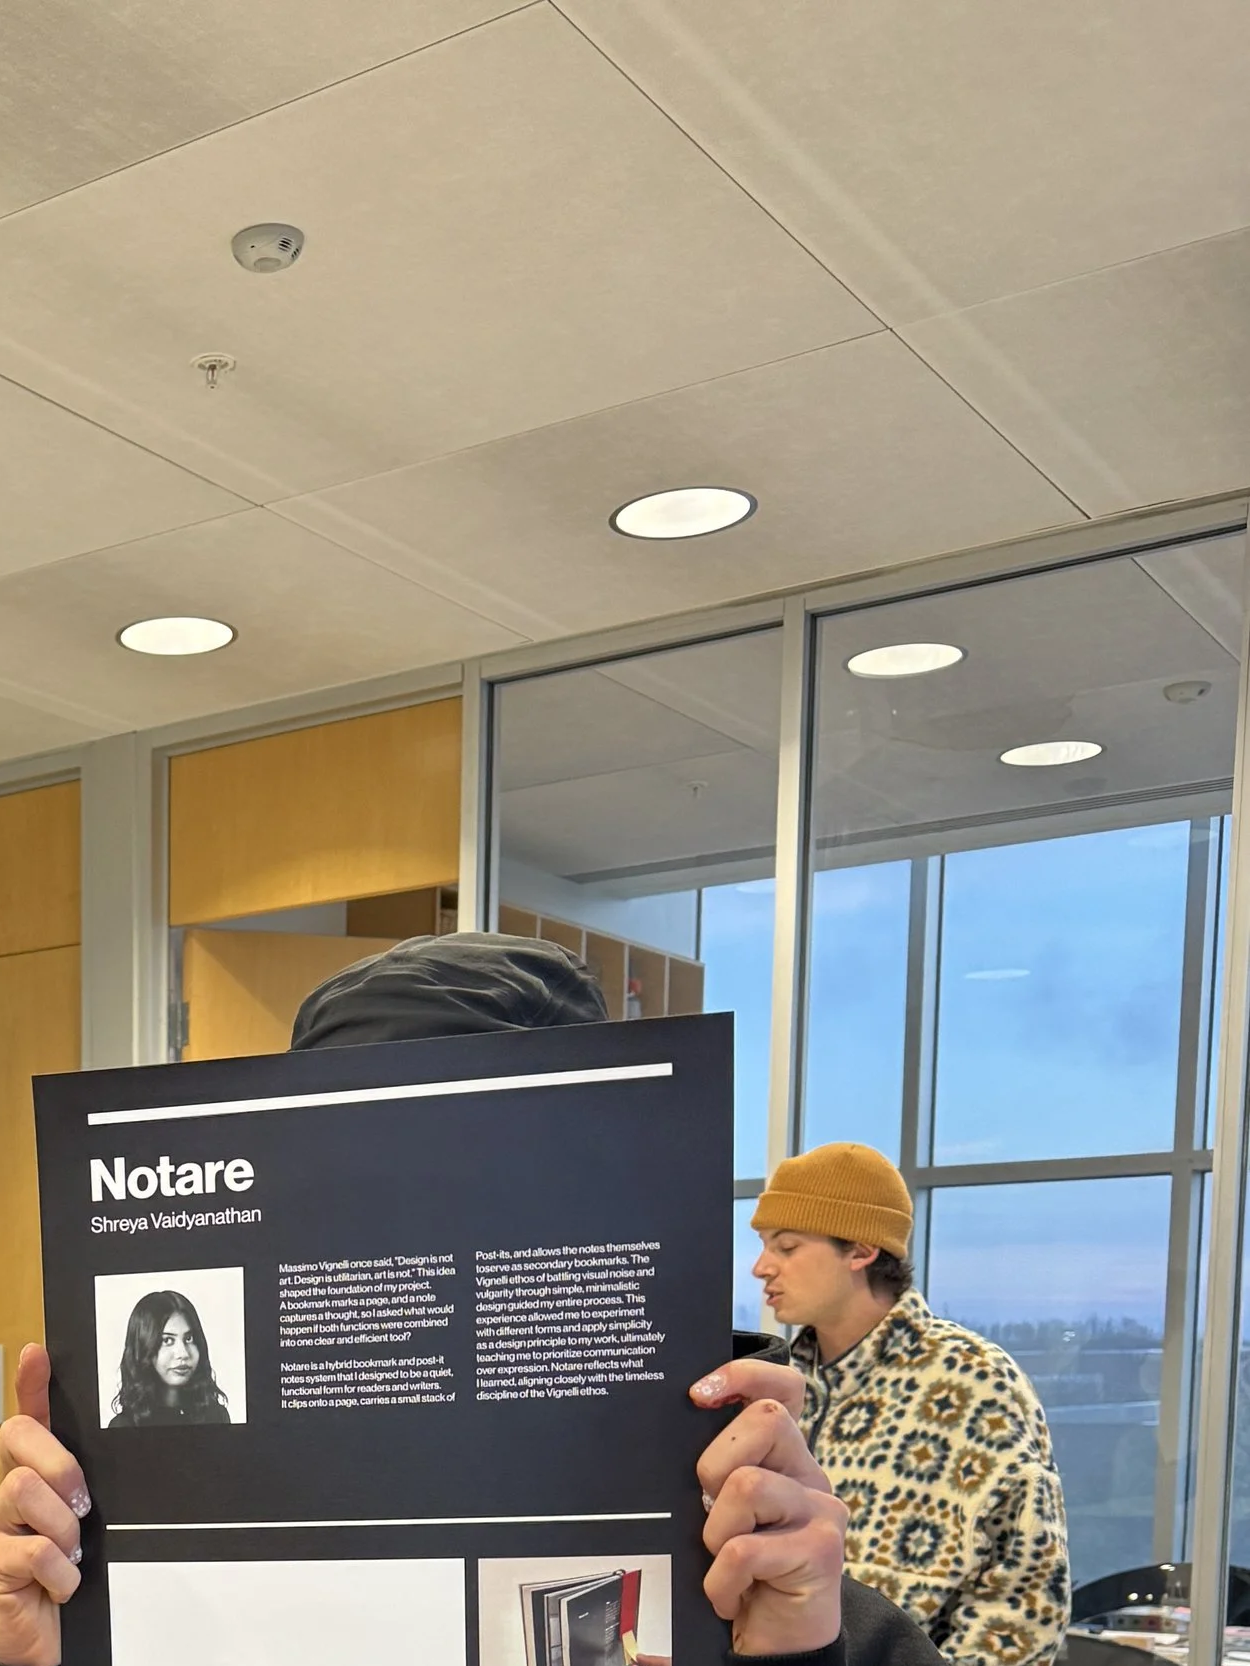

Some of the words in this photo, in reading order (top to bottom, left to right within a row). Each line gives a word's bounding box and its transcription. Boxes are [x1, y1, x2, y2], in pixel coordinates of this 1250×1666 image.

[90, 1156, 254, 1202] Notare
[91, 1216, 148, 1234] Shreya
[151, 1208, 261, 1230] Vaidyanathan
[513, 1248, 530, 1258] and
[532, 1247, 560, 1256] allows
[562, 1246, 577, 1254] the
[578, 1244, 605, 1253] notes
[606, 1241, 660, 1252] themselves
[279, 1263, 318, 1272] Massimo
[318, 1259, 348, 1271] Vignelli
[350, 1260, 372, 1268] once
[438, 1254, 452, 1262] not
[523, 1259, 572, 1270] secondary
[574, 1255, 628, 1267] bookmarks.
[630, 1254, 649, 1263] The
[279, 1276, 292, 1285] art.
[294, 1274, 324, 1285] Design
[374, 1270, 386, 1279] art
[416, 1267, 435, 1276] This
[436, 1266, 455, 1275] idea
[476, 1275, 508, 1287] Vignelli
[509, 1274, 534, 1284] ethos
[546, 1271, 580, 1282] battling
[582, 1269, 608, 1279] visual
[609, 1268, 635, 1278] noise
[636, 1266, 654, 1276] and
[279, 1287, 311, 1298] shaped
[312, 1287, 326, 1295] the
[327, 1284, 372, 1294] foundation
[398, 1280, 431, 1292] project.
[476, 1288, 514, 1300] vulgarity
[515, 1285, 550, 1297] through
[586, 1280, 639, 1292] minimalistic
[287, 1298, 330, 1309] bookmark
[331, 1297, 358, 1307] marks
[391, 1294, 408, 1303] and
[416, 1293, 436, 1302] note
[476, 1301, 506, 1312] design
[507, 1299, 538, 1311] guided
[556, 1297, 582, 1307] entire
[583, 1296, 623, 1307] process.
[625, 1293, 645, 1303] This
[280, 1313, 317, 1323] captures
[376, 1307, 402, 1317] asked
[404, 1306, 425, 1315] what
[426, 1304, 454, 1314] would
[476, 1313, 526, 1325] experience
[528, 1311, 563, 1321] allowed
[592, 1307, 644, 1319] experiment
[280, 1326, 312, 1335] happen
[319, 1323, 338, 1332] both
[340, 1321, 379, 1331] functions
[380, 1321, 402, 1329] were
[404, 1317, 448, 1328] combined
[476, 1327, 494, 1337] with
[496, 1325, 532, 1336] different
[534, 1324, 561, 1333] forms
[562, 1322, 580, 1332] and
[582, 1321, 607, 1332] apply
[608, 1319, 652, 1330] simplicity
[280, 1338, 296, 1346] into
[314, 1336, 335, 1345] clear
[336, 1335, 353, 1344] and
[354, 1333, 388, 1343] efficient
[495, 1339, 526, 1349] design
[527, 1336, 566, 1348] principle
[620, 1332, 664, 1342] ultimately
[476, 1352, 514, 1362] teaching
[543, 1348, 582, 1360] prioritize
[583, 1345, 655, 1357] communication
[280, 1363, 309, 1371] Notare
[325, 1360, 352, 1371] hybrid
[353, 1357, 396, 1368] bookmark
[398, 1357, 415, 1365] and
[476, 1367, 496, 1375] over
[497, 1364, 549, 1374] expression.
[551, 1362, 582, 1371] Notare
[584, 1360, 618, 1369] reflects
[620, 1358, 643, 1368] what
[281, 1375, 304, 1383] notes
[305, 1374, 336, 1384] system
[337, 1372, 353, 1381] that
[358, 1370, 398, 1381] designed
[518, 1376, 552, 1387] aligning
[554, 1374, 586, 1384] closely
[587, 1373, 606, 1382] with
[608, 1372, 623, 1381] the
[625, 1371, 664, 1380] timeless
[281, 1385, 322, 1396] functional
[323, 1385, 342, 1394] form
[344, 1384, 355, 1393] for
[357, 1383, 390, 1392] readers
[392, 1382, 408, 1391] and
[409, 1381, 441, 1390] writers.
[476, 1390, 518, 1400] discipline
[530, 1389, 544, 1397] the
[546, 1386, 578, 1398] Vignelli
[580, 1386, 608, 1395] ethos.
[288, 1399, 307, 1409] clips
[308, 1398, 328, 1407] onto
[360, 1395, 389, 1405] carries
[398, 1394, 420, 1403] small
[421, 1393, 445, 1402] stack
